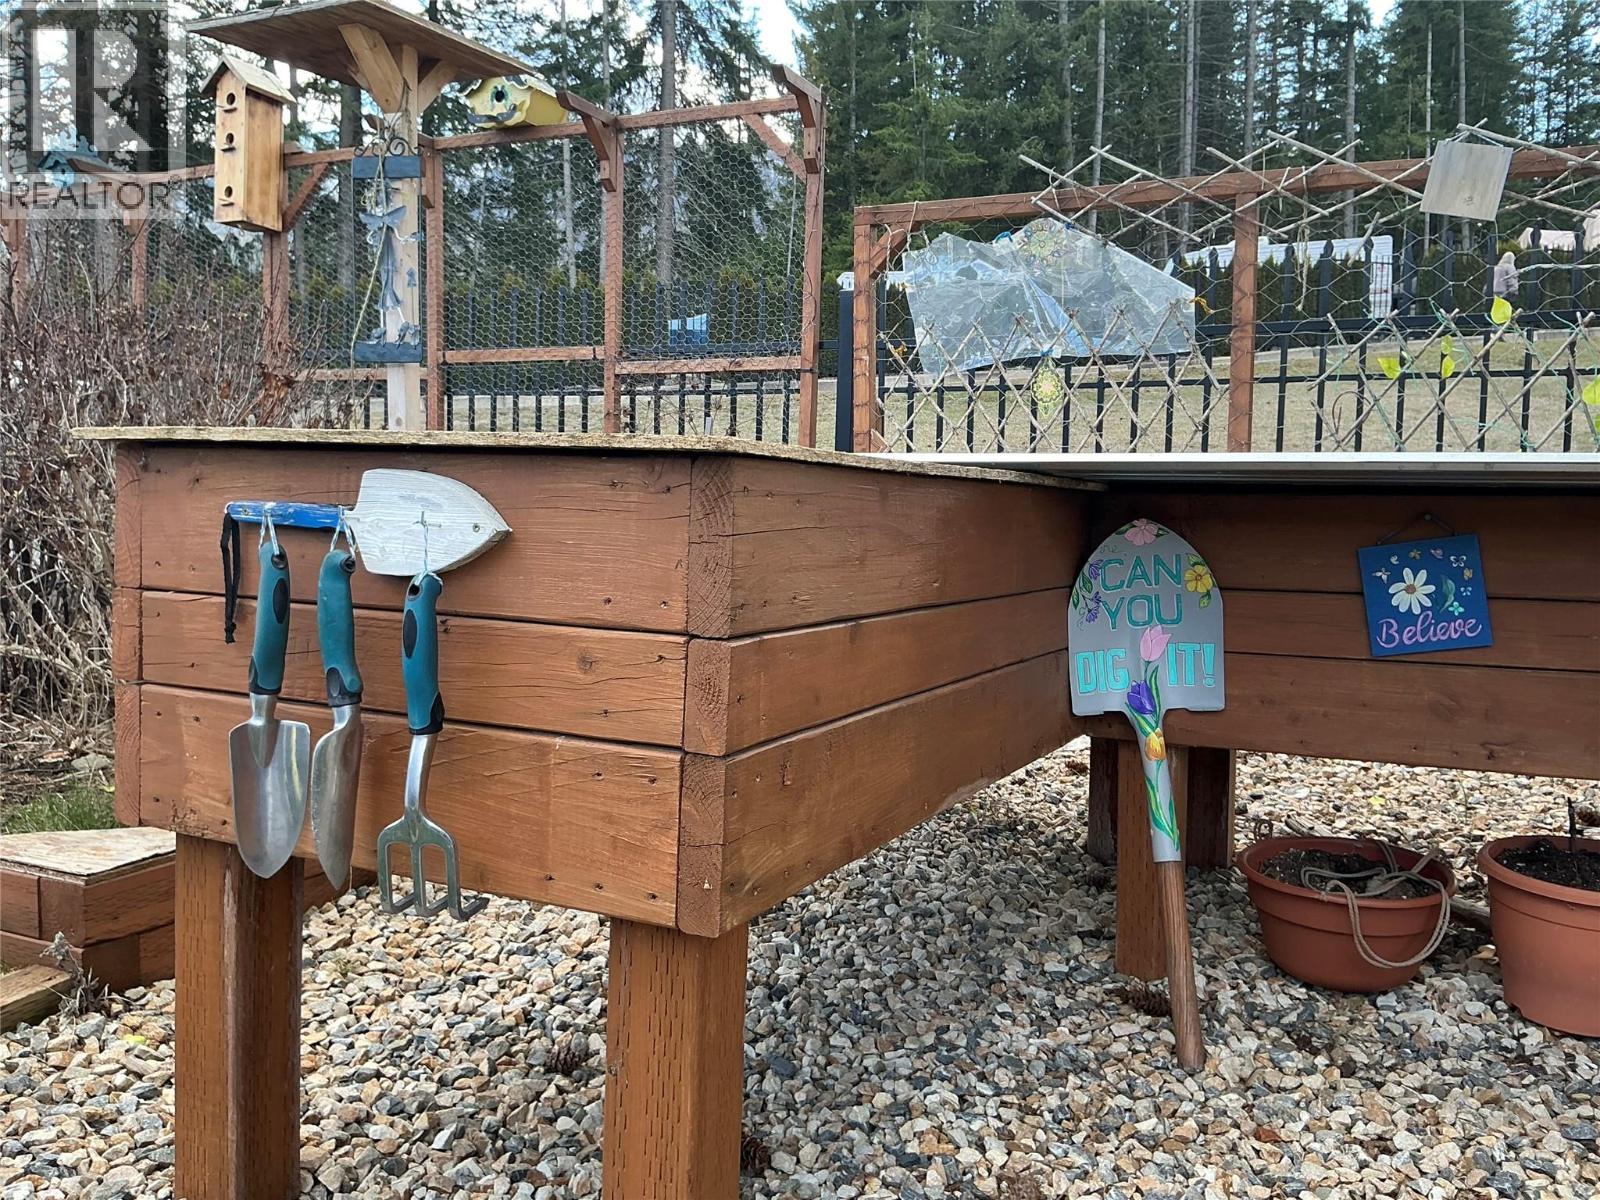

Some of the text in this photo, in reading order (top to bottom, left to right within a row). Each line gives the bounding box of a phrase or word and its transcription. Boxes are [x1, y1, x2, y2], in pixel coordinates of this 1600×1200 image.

[1100, 554, 1182, 593] CAN
[1100, 593, 1183, 630] YOU
[1376, 611, 1482, 648] Believe
[1075, 643, 1216, 694] DIG IT!
